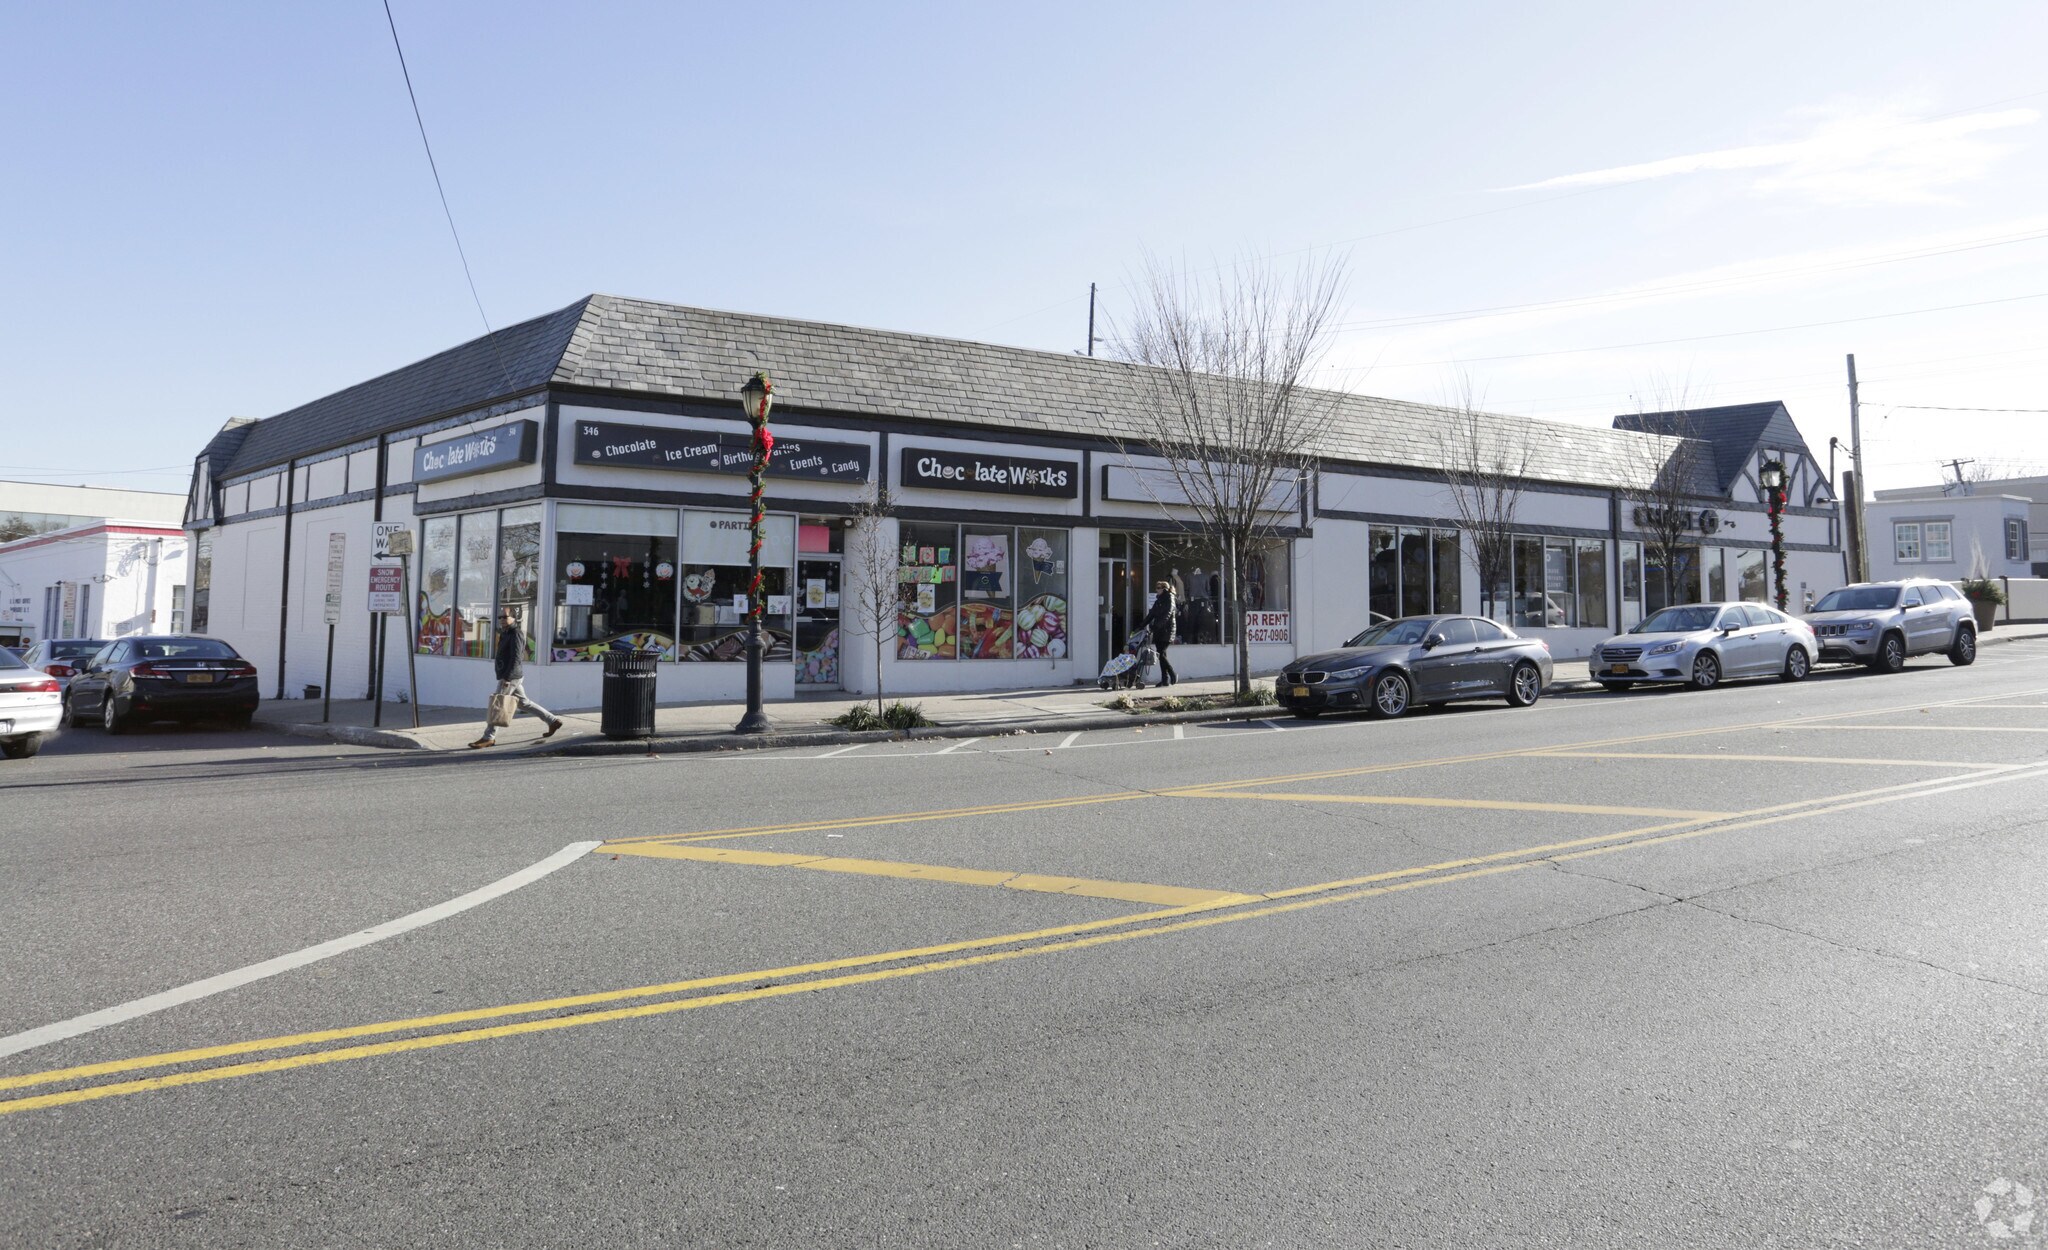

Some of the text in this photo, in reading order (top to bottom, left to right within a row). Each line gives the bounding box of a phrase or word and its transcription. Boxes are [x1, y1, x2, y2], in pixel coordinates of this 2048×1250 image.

[583, 426, 599, 436] 346
[605, 439, 657, 457] Chocolate
[665, 443, 718, 461] Ice Cream
[723, 443, 801, 465] Birthd arties
[423, 446, 464, 471] Choclate
[790, 455, 823, 471] Events
[831, 460, 860, 473] Candy
[917, 457, 1068, 488] Chocolate Works
[719, 521, 750, 530] PARTI
[377, 568, 395, 576] SNOW
[370, 576, 401, 584] EMERGENCY
[375, 583, 395, 591] ROUTE
[1247, 613, 1289, 626] OR RENT
[1248, 628, 1289, 642] 6-627-0906
